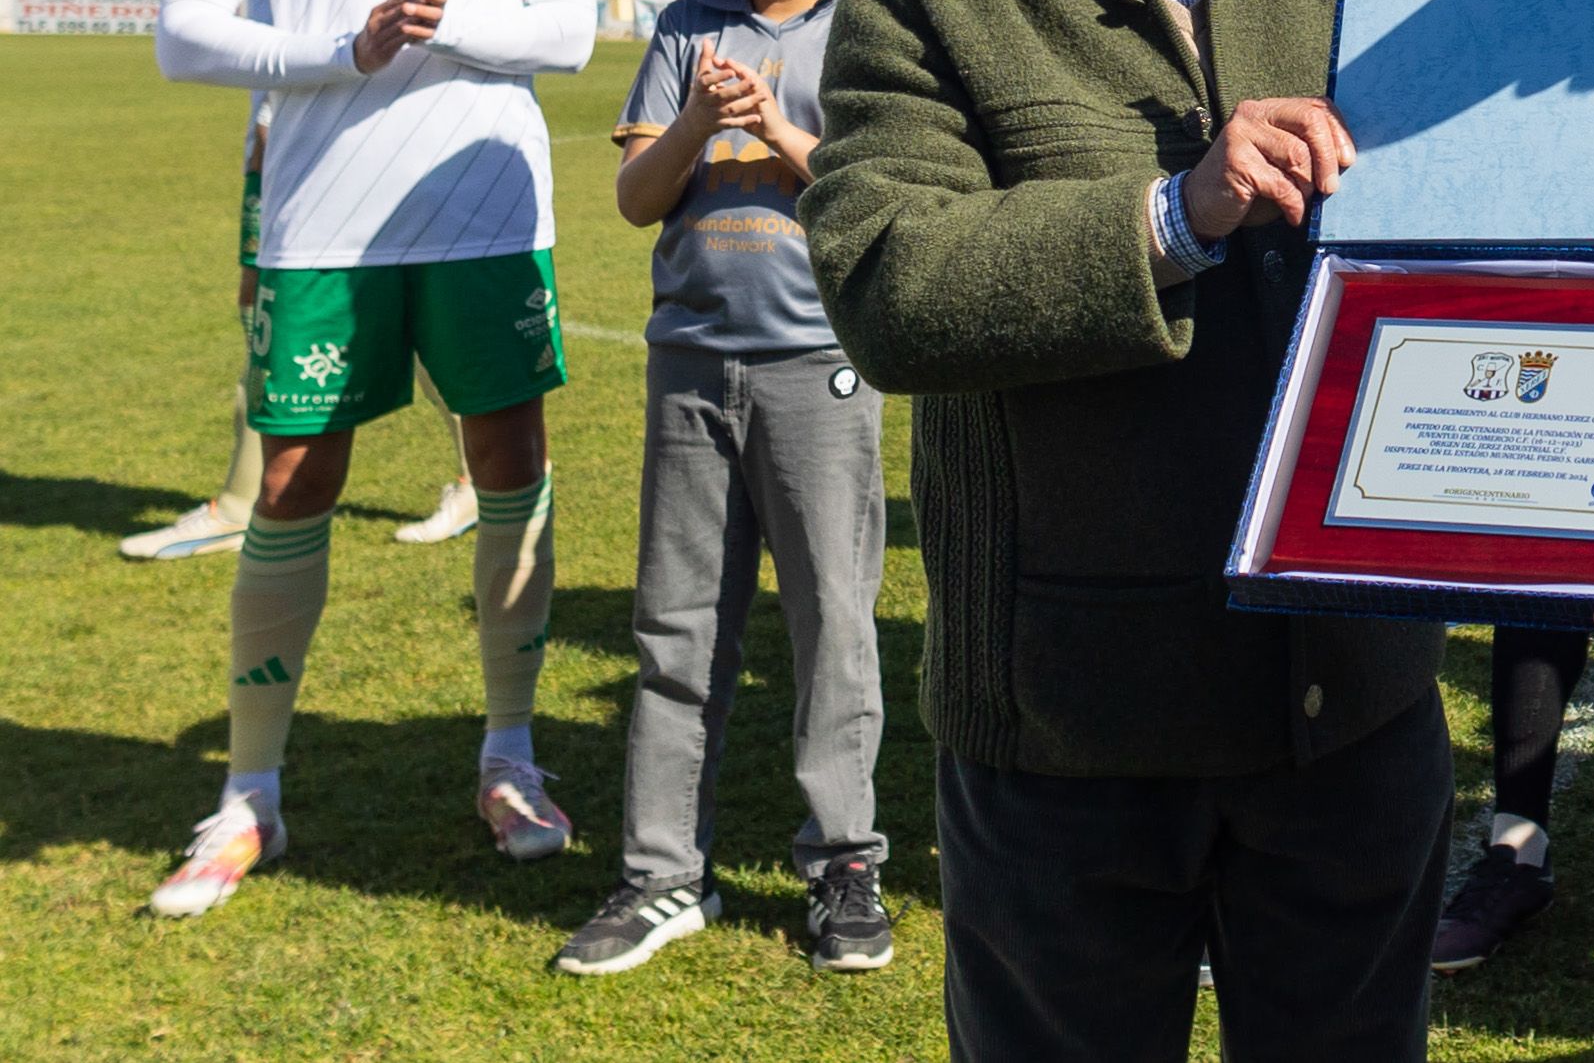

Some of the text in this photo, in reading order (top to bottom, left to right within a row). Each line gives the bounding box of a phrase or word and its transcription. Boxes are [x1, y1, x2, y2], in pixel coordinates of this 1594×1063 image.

[705, 237, 775, 253] Network
[1403, 406, 1414, 414] EN
[1416, 407, 1487, 418] AGRADECIMIENTO
[1500, 411, 1521, 419] CLUB
[1522, 412, 1564, 422] HERMANO
[1564, 415, 1591, 423] XEREZ
[1405, 422, 1440, 430] PARTIDO
[1441, 424, 1457, 432] DEL
[1458, 426, 1510, 434] CENTENARIO
[1418, 432, 1459, 440] JUVENTUD
[1472, 434, 1514, 443] COMERCIO
[1384, 446, 1429, 454] DISPUTADO
[1442, 448, 1454, 456] EL
[1454, 449, 1488, 458] ESTADIO
[1490, 451, 1536, 461] MUNICIPAL
[1536, 454, 1564, 462] PEDRO
[1430, 440, 1460, 448] ORIGEN
[1503, 444, 1551, 453] INDUSTRIAL
[1422, 464, 1434, 472] DE
[1446, 466, 1491, 476] FRONTERA,
[1504, 468, 1516, 476] DE
[1516, 470, 1554, 478] FEBRERO
[1555, 472, 1568, 480] DE
